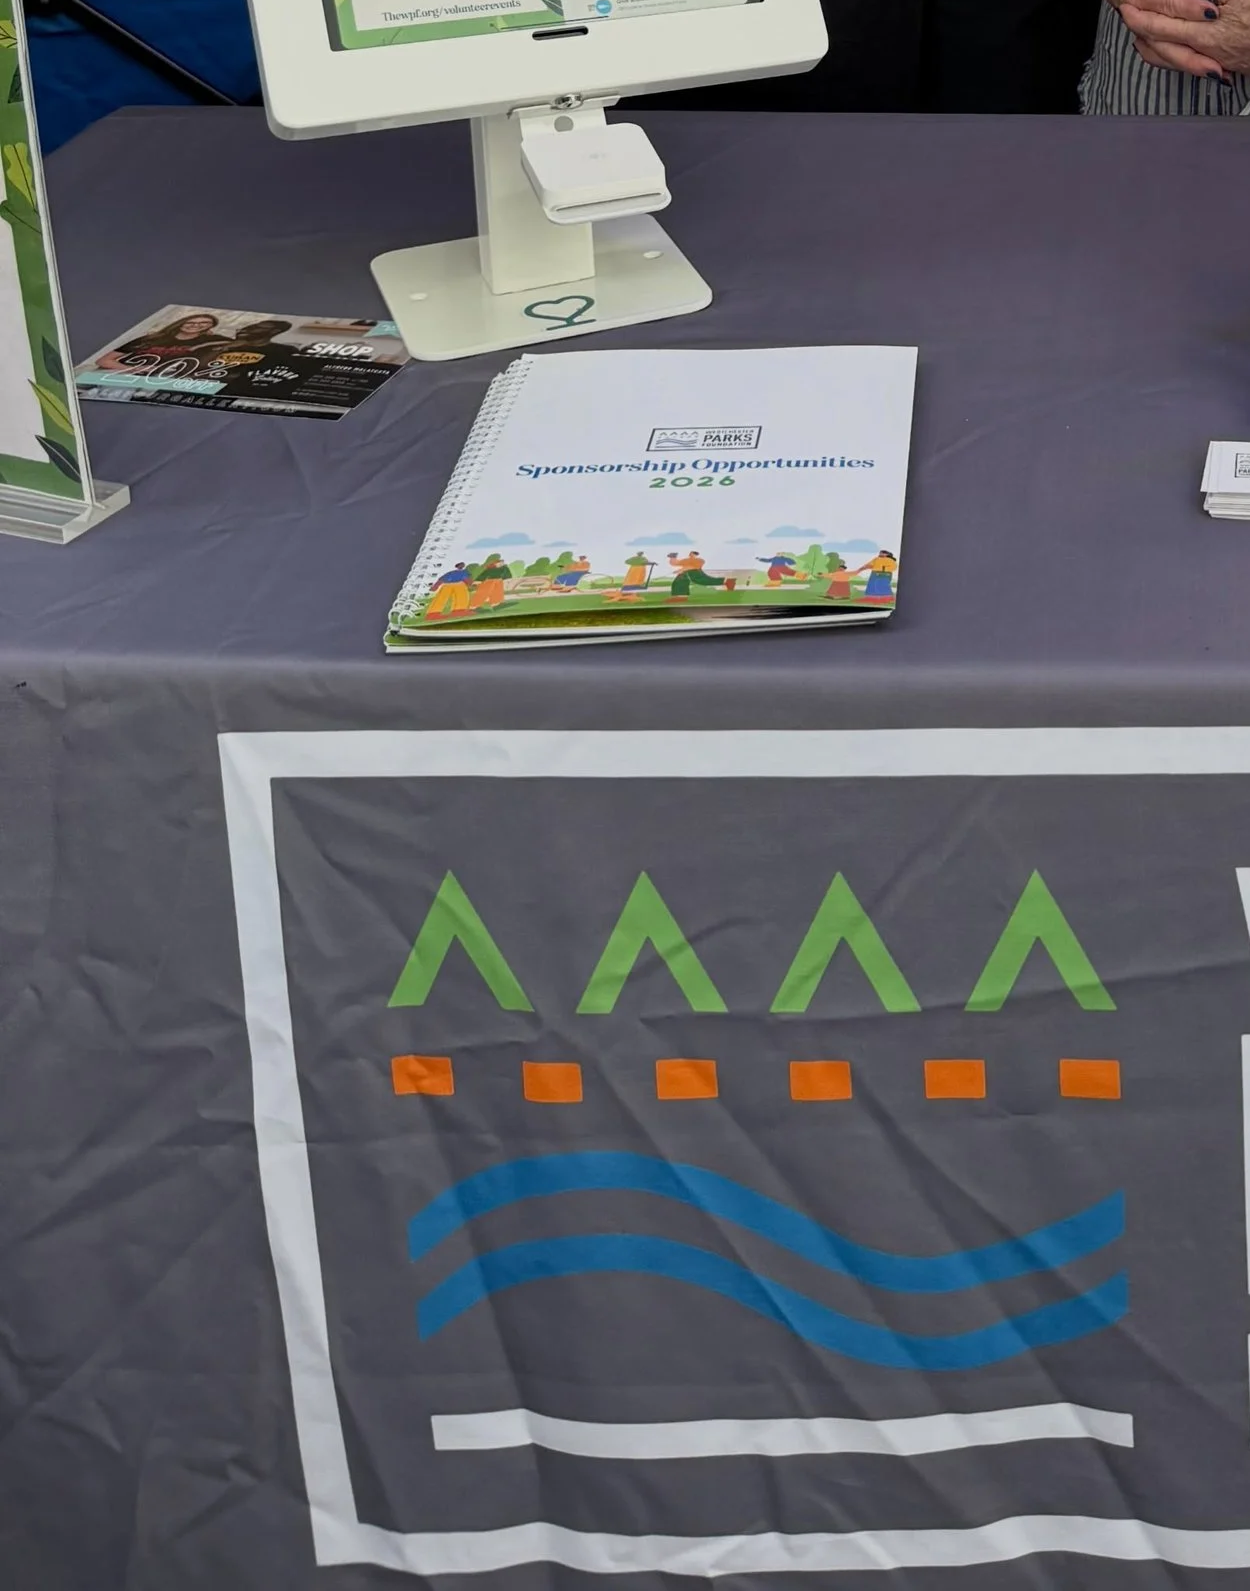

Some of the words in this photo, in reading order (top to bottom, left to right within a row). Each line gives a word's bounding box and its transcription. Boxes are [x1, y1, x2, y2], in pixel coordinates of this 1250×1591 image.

[382, 0, 521, 22] Thewpf.org/volunteerevents
[307, 342, 374, 356] SHOP
[100, 353, 240, 385] 20%
[173, 377, 220, 390] OFF
[703, 434, 753, 442] PARKS
[515, 459, 686, 478] Sponsorship
[692, 455, 875, 473] Opportunities
[649, 476, 735, 488] 2026
